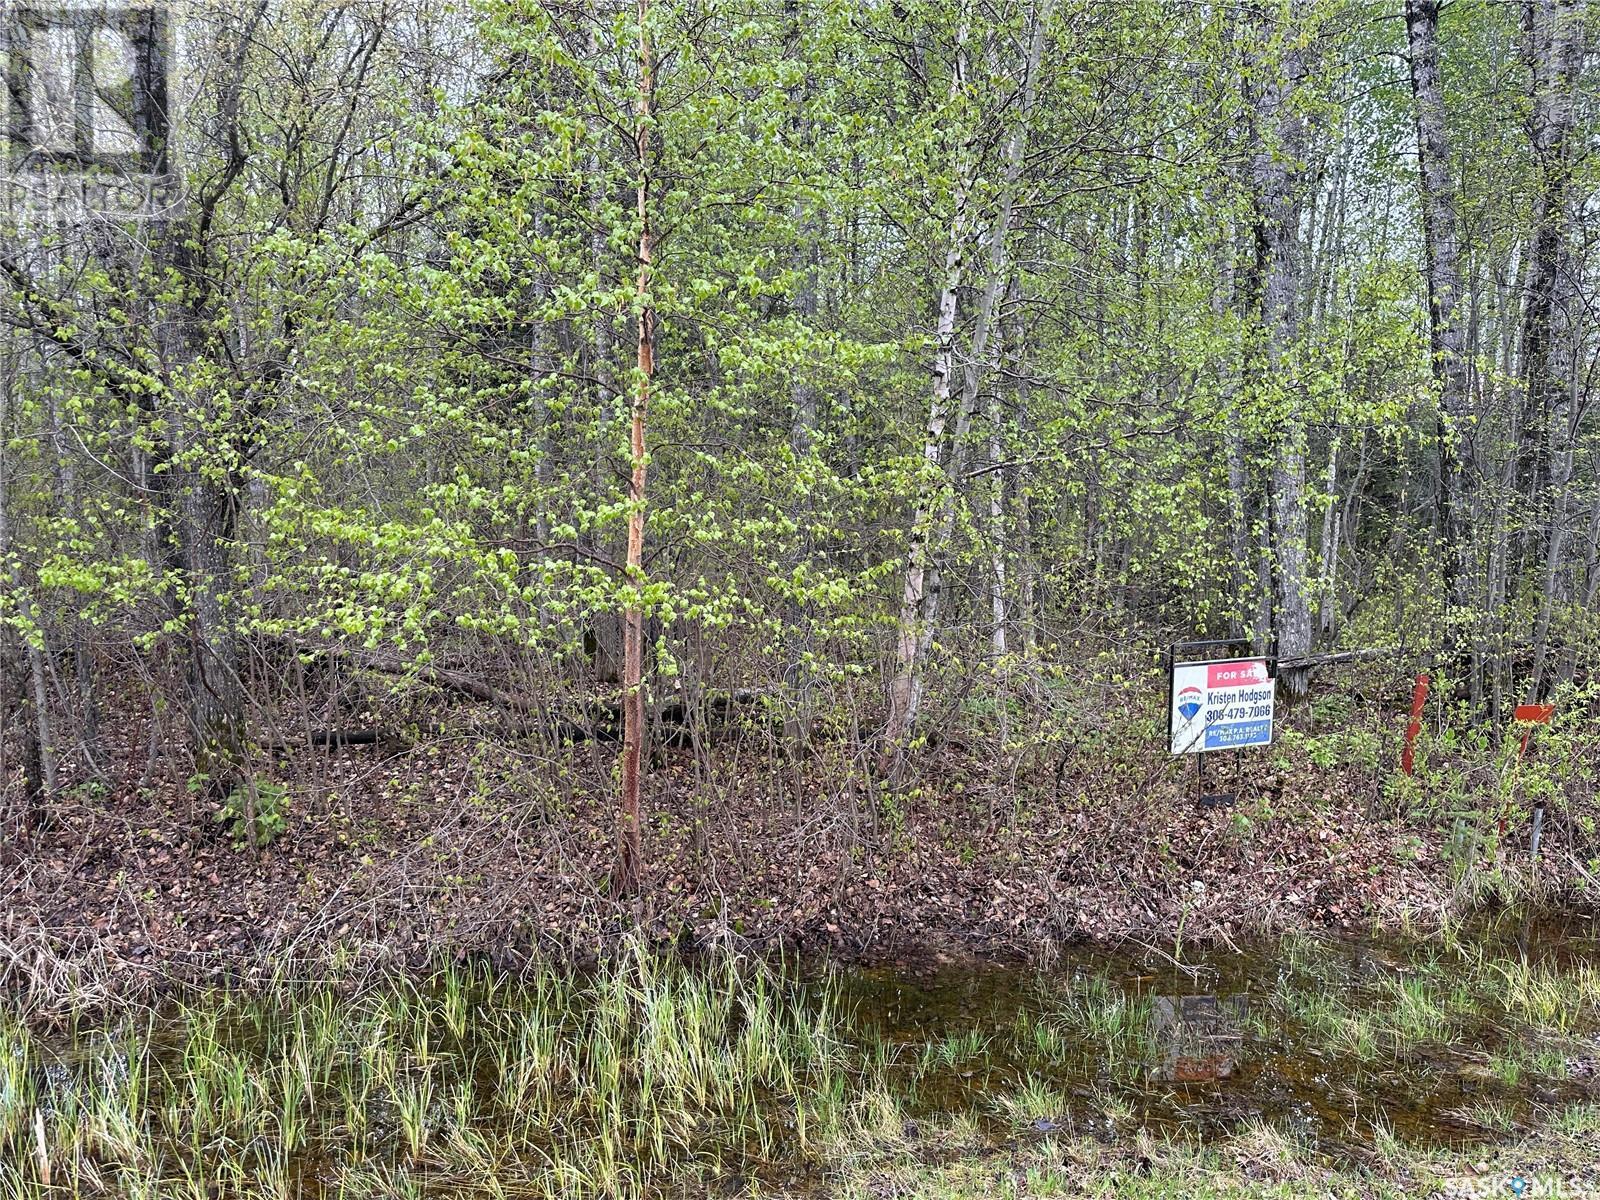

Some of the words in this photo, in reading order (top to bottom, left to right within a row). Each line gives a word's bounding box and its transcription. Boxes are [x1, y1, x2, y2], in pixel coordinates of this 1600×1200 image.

[1216, 671, 1237, 680] FOR
[1207, 691, 1236, 705] Kristen
[1238, 688, 1272, 705] Hodgson
[1206, 705, 1271, 722] 306-479-7066
